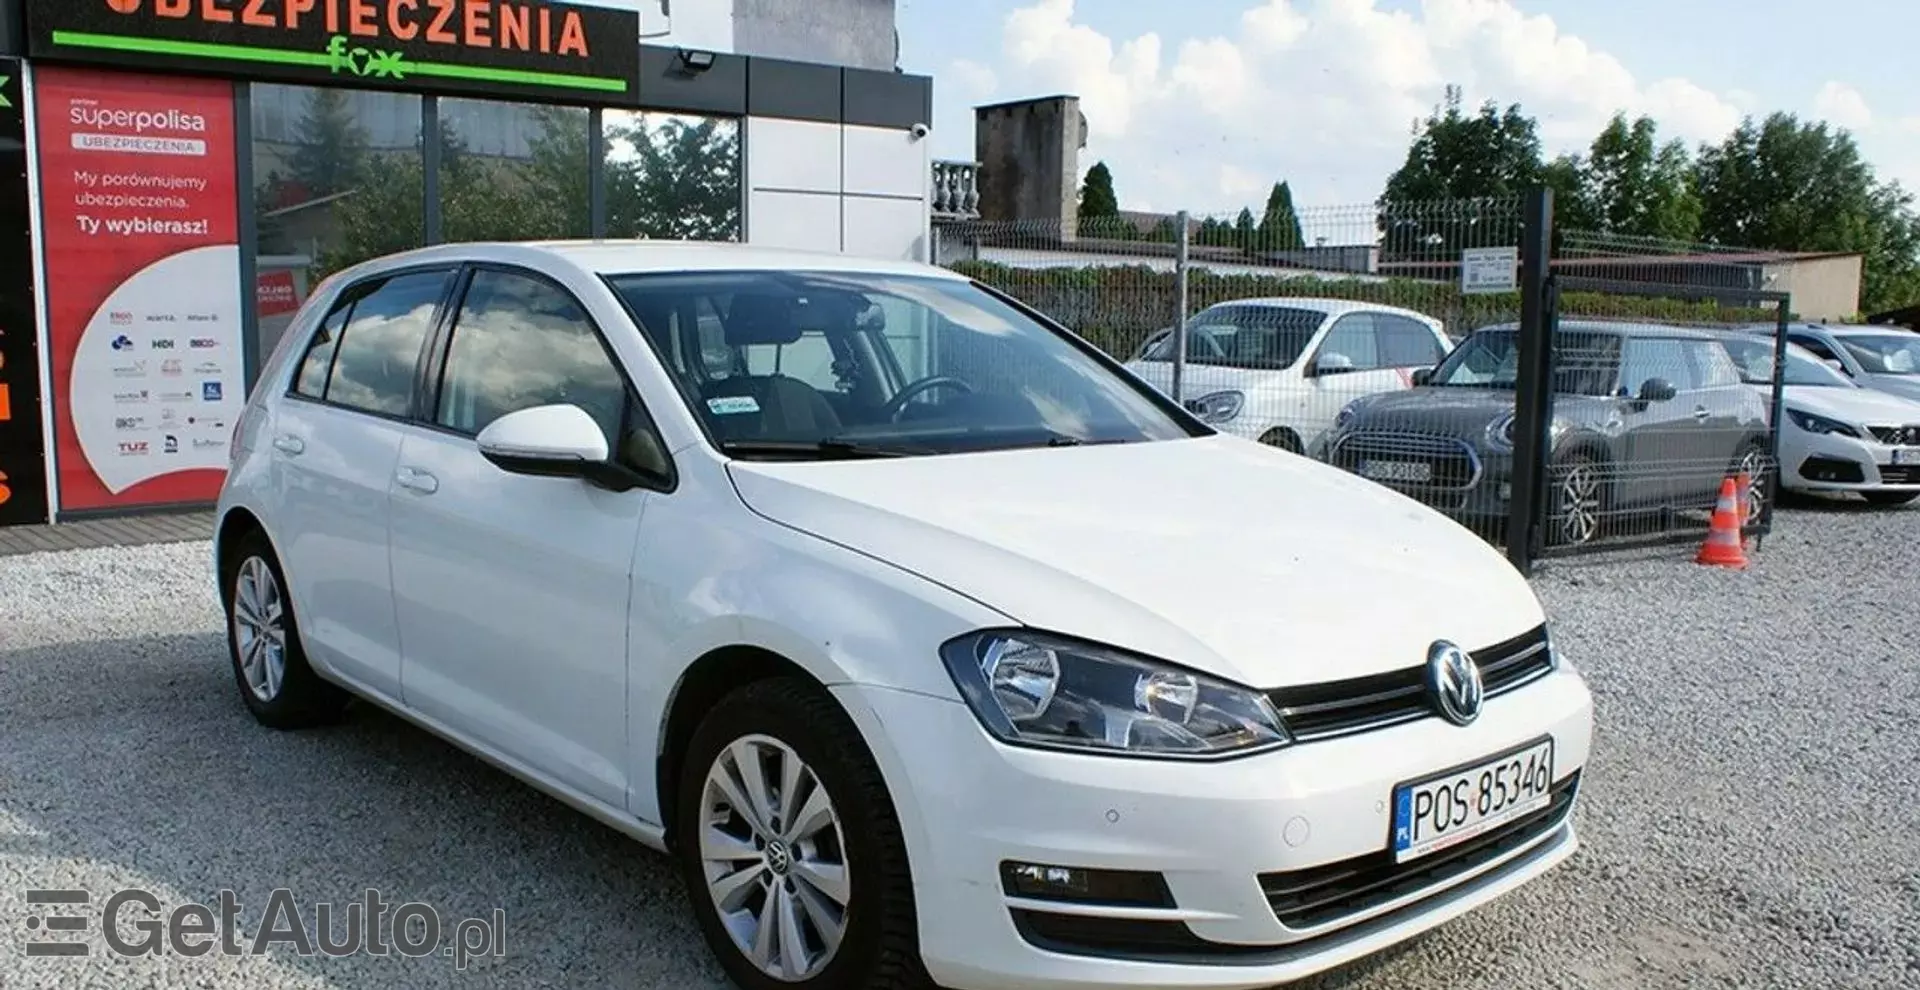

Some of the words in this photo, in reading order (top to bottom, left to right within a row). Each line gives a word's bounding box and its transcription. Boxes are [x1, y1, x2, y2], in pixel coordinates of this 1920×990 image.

[106, 0, 590, 57] ZPIECZENIA
[70, 107, 205, 132] superpolisa
[82, 136, 195, 152] UBEZPIECZENIA
[74, 171, 98, 187] My
[102, 172, 207, 191] porównujemy
[75, 191, 189, 208] ubezpieczenia.
[76, 215, 101, 235] Ty
[105, 216, 208, 235] wybierasz!
[118, 442, 149, 452] TUZ
[1414, 779, 1469, 841] POS
[1478, 747, 1548, 816] 85346
